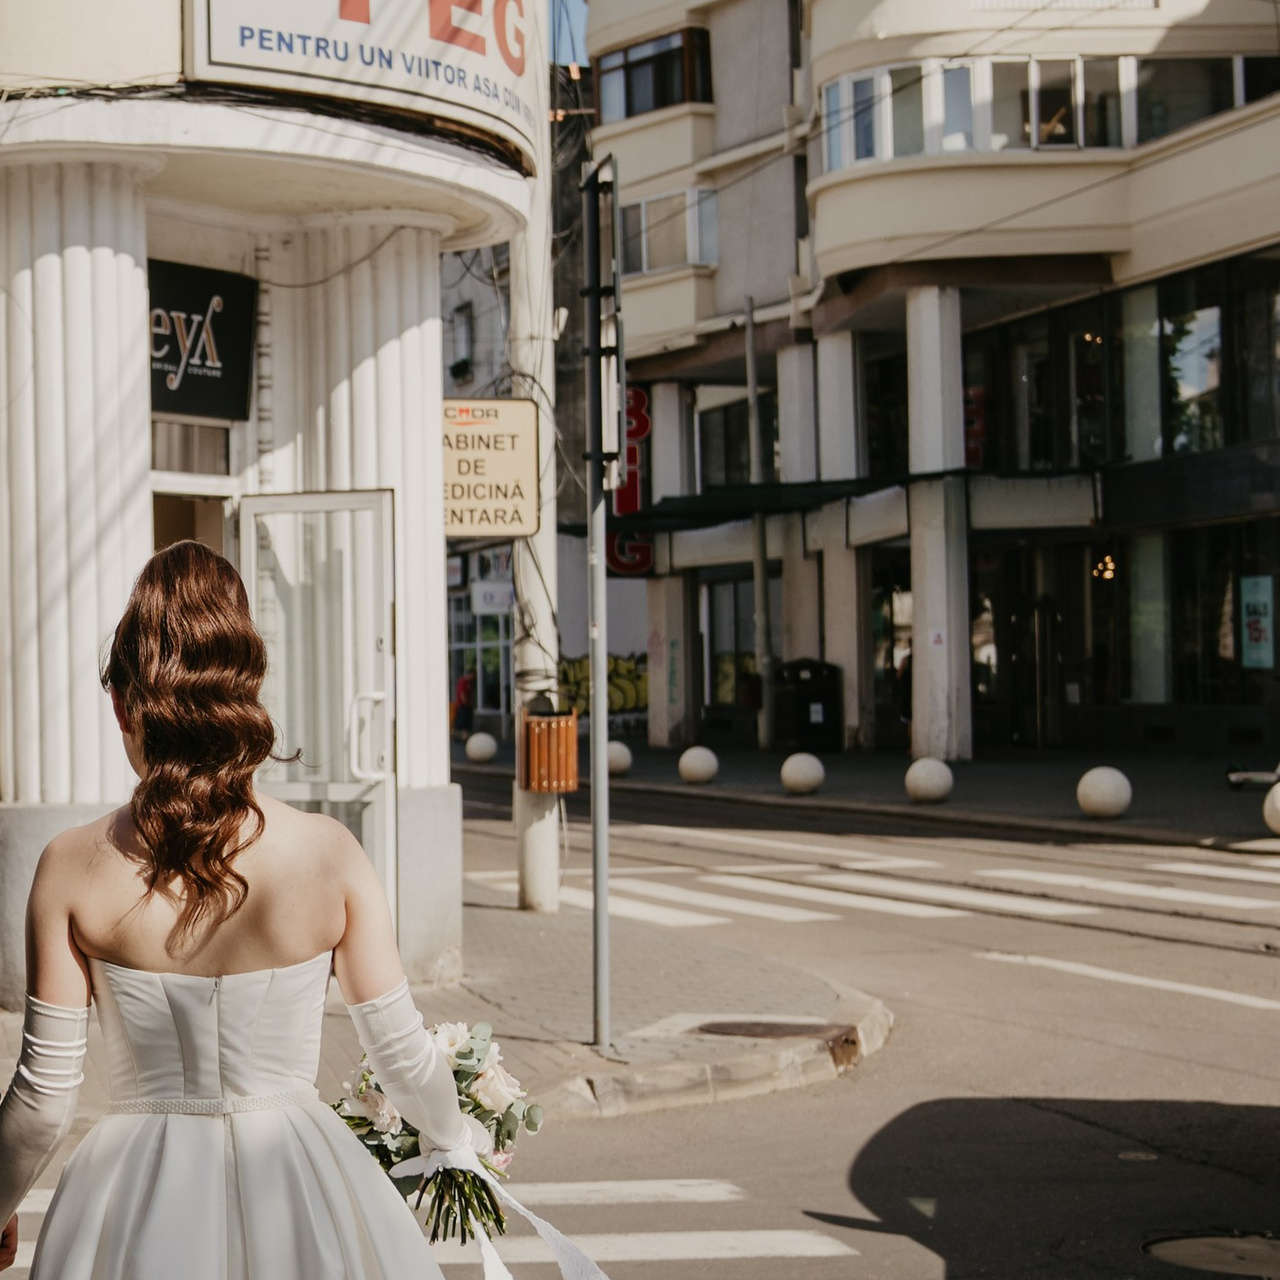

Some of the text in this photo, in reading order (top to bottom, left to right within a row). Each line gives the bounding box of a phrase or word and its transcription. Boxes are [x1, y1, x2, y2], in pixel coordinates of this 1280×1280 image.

[239, 25, 349, 63] PENTRU
[359, 44, 393, 70] UN
[401, 52, 467, 90] VIITOR
[442, 433, 519, 451] ABINET
[457, 458, 487, 477] DE
[443, 479, 525, 501] DICINĂ
[443, 504, 524, 526] NTARĂ
